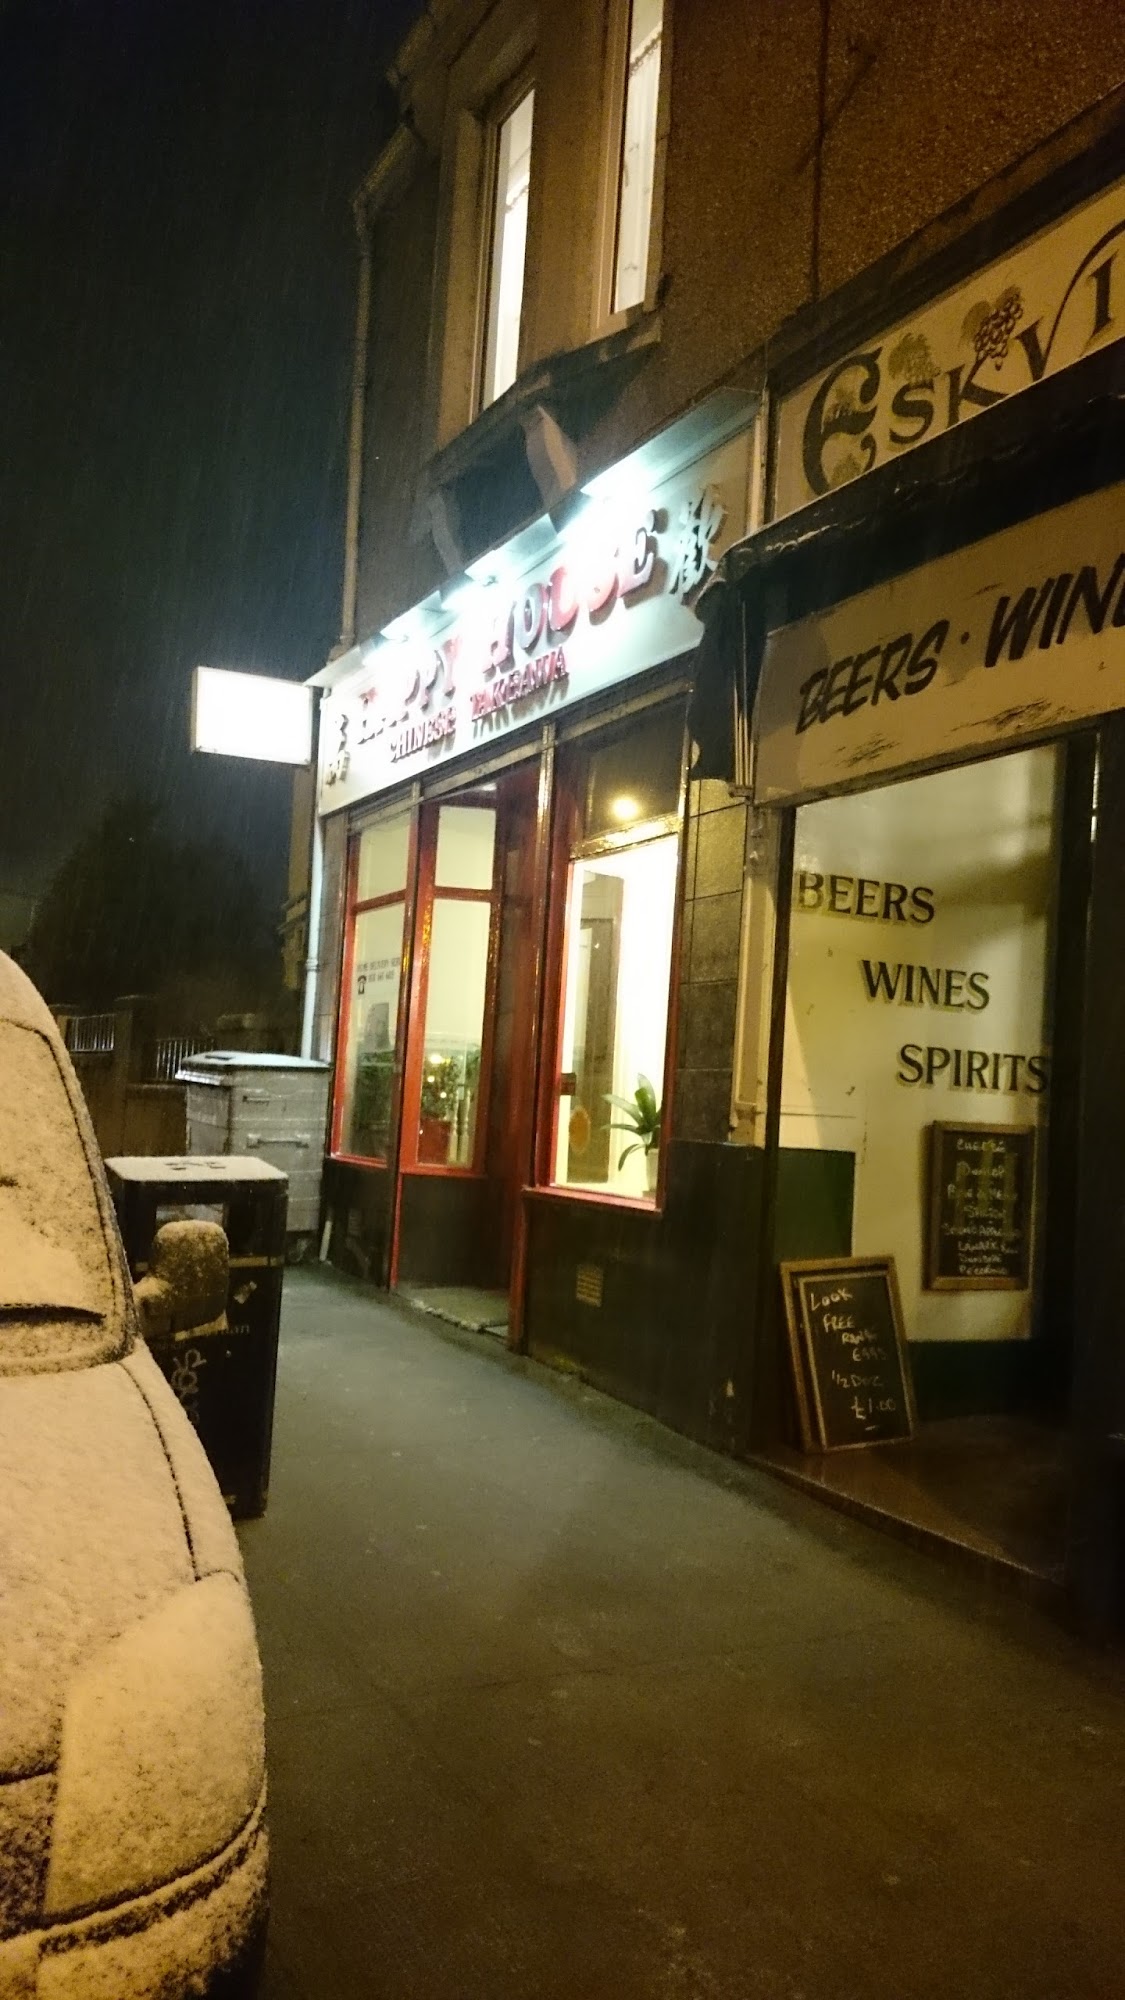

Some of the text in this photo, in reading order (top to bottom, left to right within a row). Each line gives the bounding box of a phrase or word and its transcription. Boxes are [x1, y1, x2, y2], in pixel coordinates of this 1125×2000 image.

[795, 619, 950, 736] BEERS
[798, 870, 936, 924] BEERS
[861, 959, 990, 1011] WINES
[898, 1043, 1049, 1094] SPIRITS
[810, 1287, 853, 1311] LOOK
[823, 1313, 856, 1334] FREE
